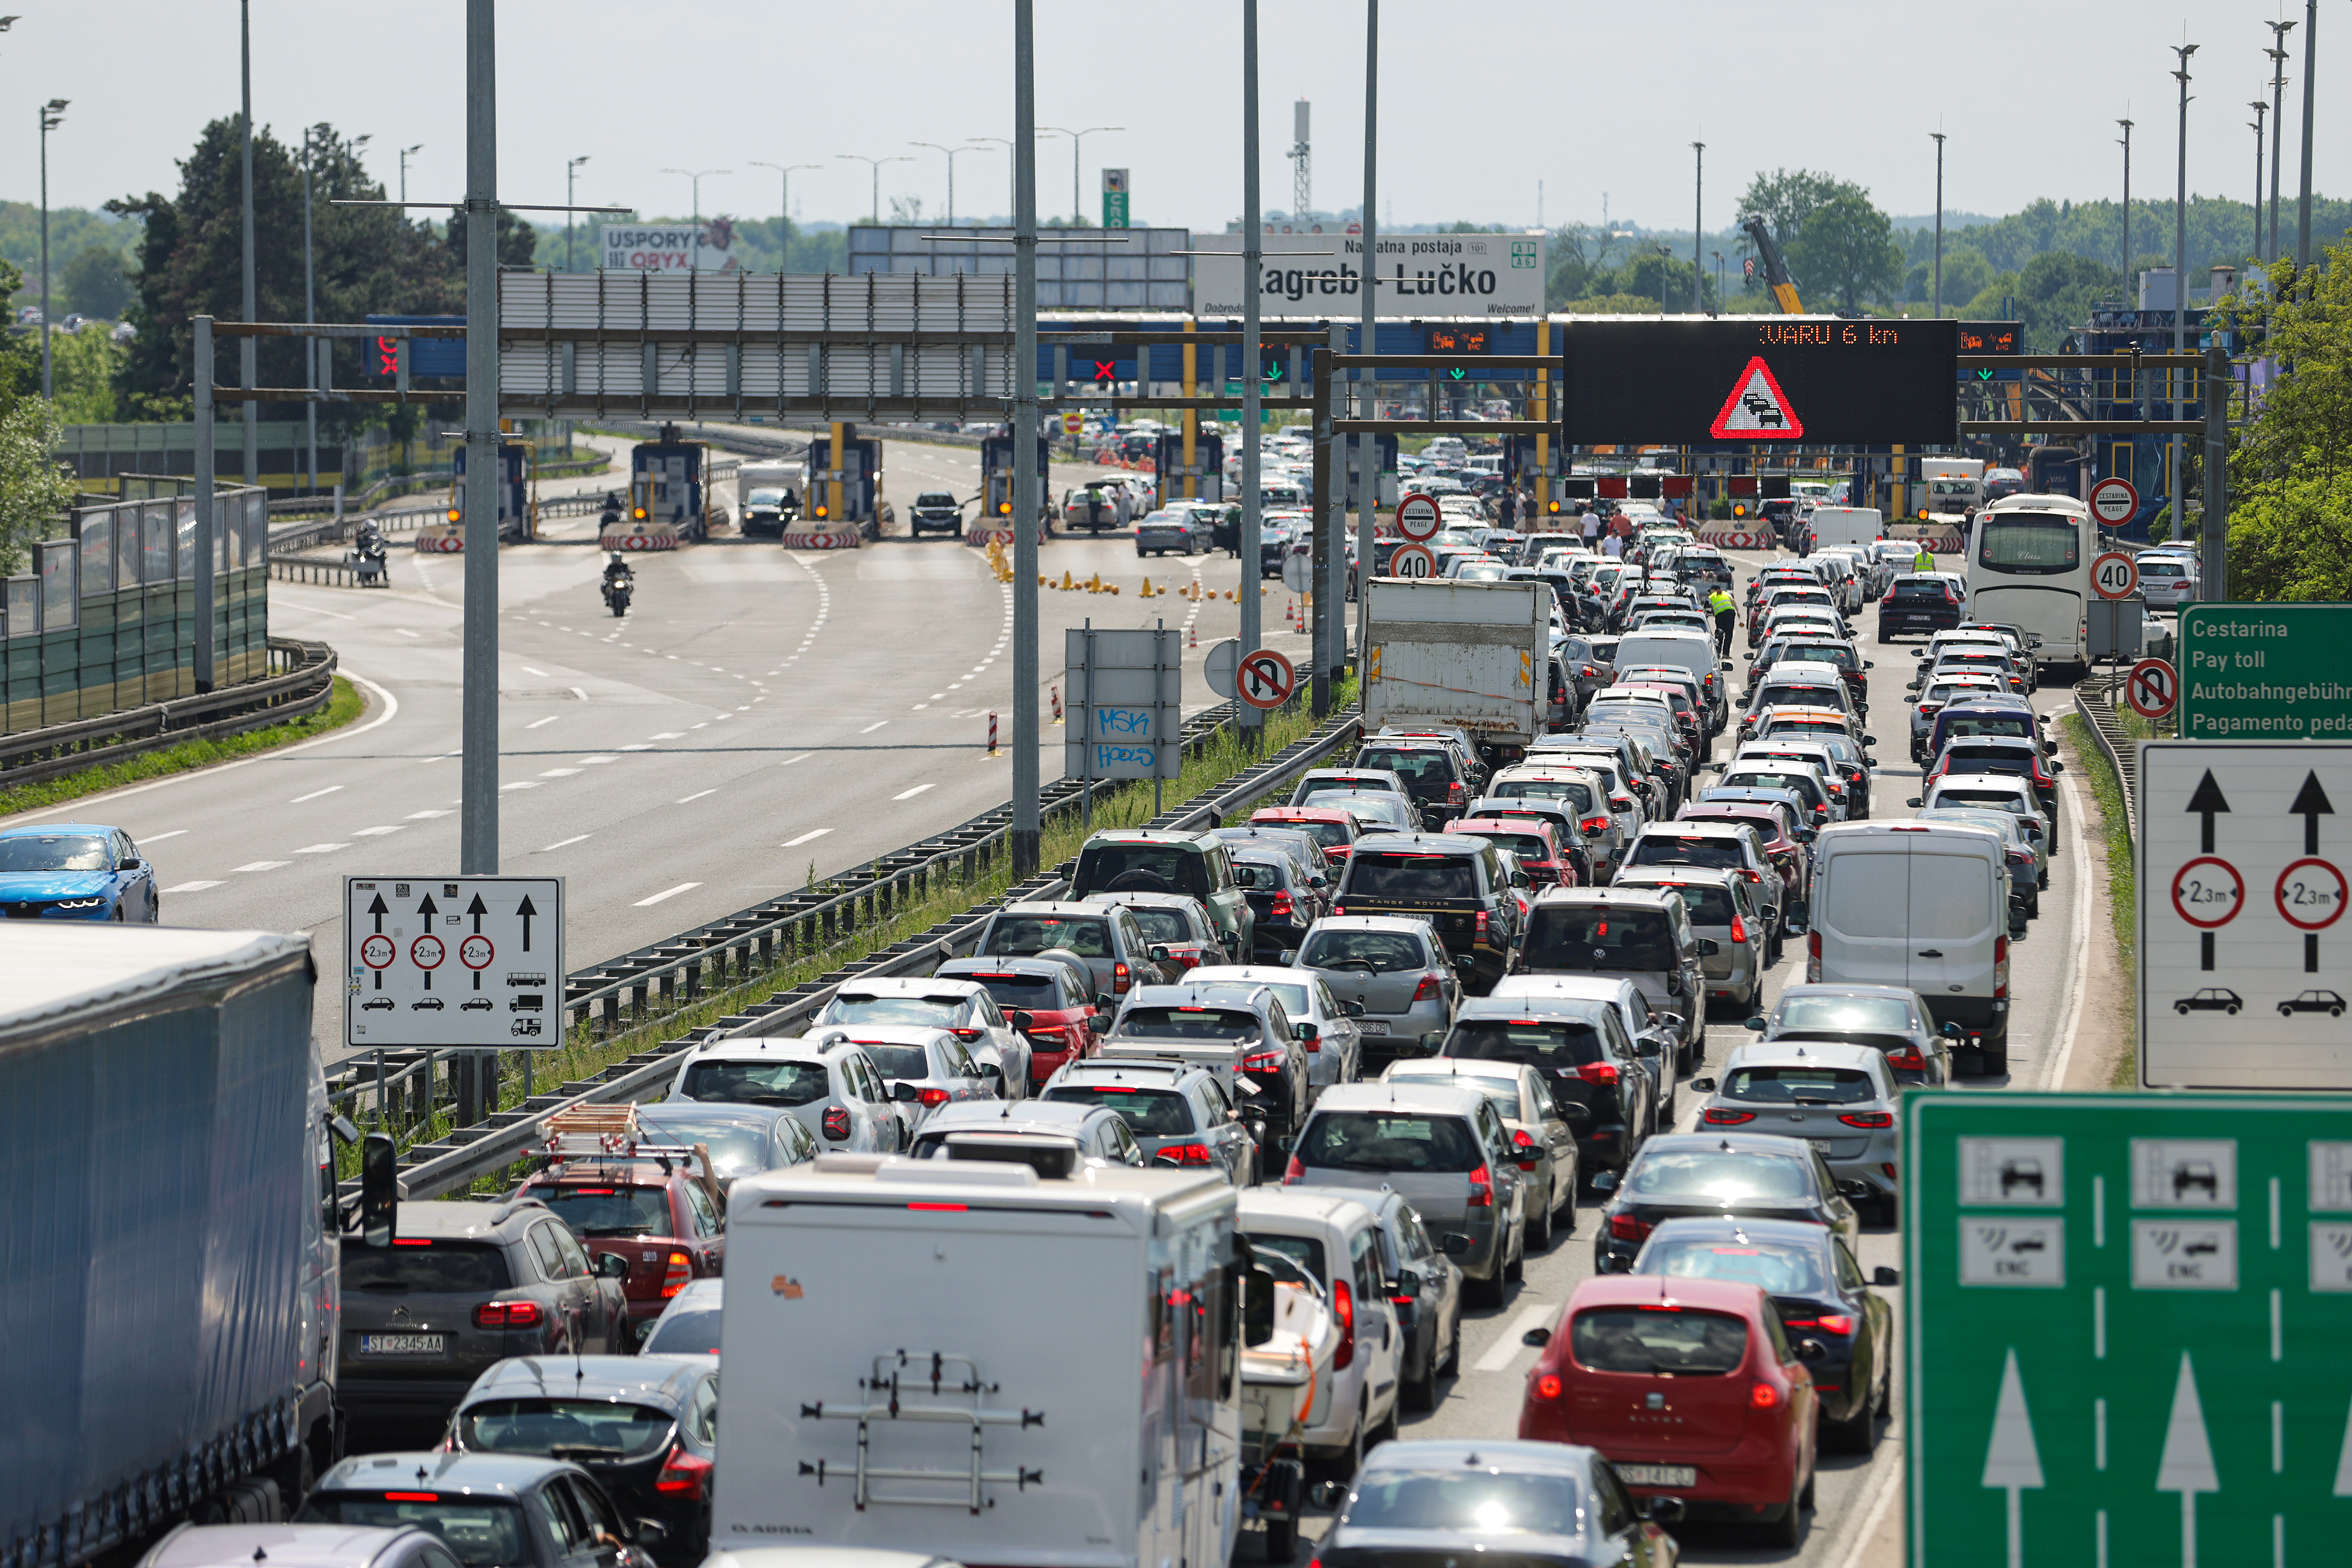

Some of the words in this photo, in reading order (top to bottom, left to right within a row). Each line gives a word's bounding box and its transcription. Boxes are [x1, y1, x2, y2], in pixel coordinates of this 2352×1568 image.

[1345, 240, 1405, 253] Naatna
[1412, 240, 1462, 256] postaja
[1259, 263, 1358, 300] agreb
[1396, 263, 1496, 295] Lučko
[1204, 302, 1245, 313] Dobrodo
[1488, 303, 1535, 313] Welcome!
[1842, 325, 1857, 344] 6
[1869, 325, 1898, 344] km
[2017, 550, 2041, 560] Class
[1400, 557, 1426, 578] 40
[2100, 565, 2127, 587] 40
[2192, 620, 2288, 637] Cestarina
[2192, 651, 2228, 672] Pay
[2234, 651, 2264, 668] toll
[2192, 713, 2303, 735] Pagamento
[370, 1337, 385, 1350] ST
